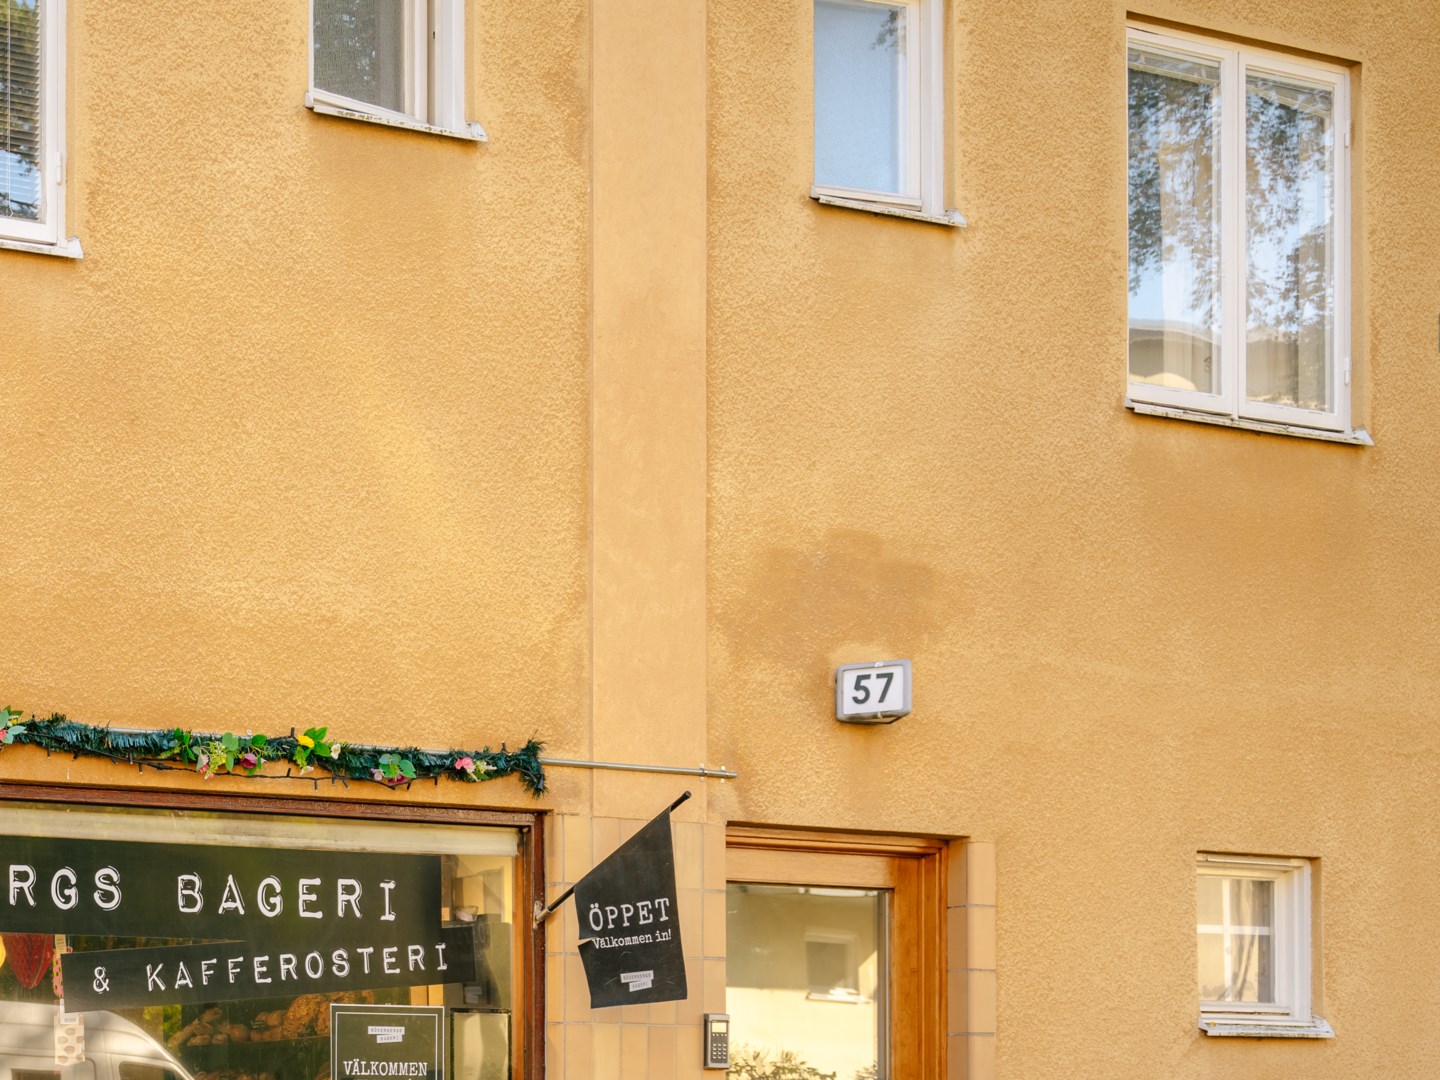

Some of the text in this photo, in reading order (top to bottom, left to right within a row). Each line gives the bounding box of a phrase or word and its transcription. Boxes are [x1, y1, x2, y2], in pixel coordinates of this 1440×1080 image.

[852, 672, 894, 704] 57
[177, 871, 397, 922] BAGERI
[589, 898, 670, 931] ÖPPET
[592, 929, 672, 949] Välkommen in!
[92, 942, 448, 994] & KAFFEROSTERI
[343, 1059, 428, 1076] VÄLKOMMEN
